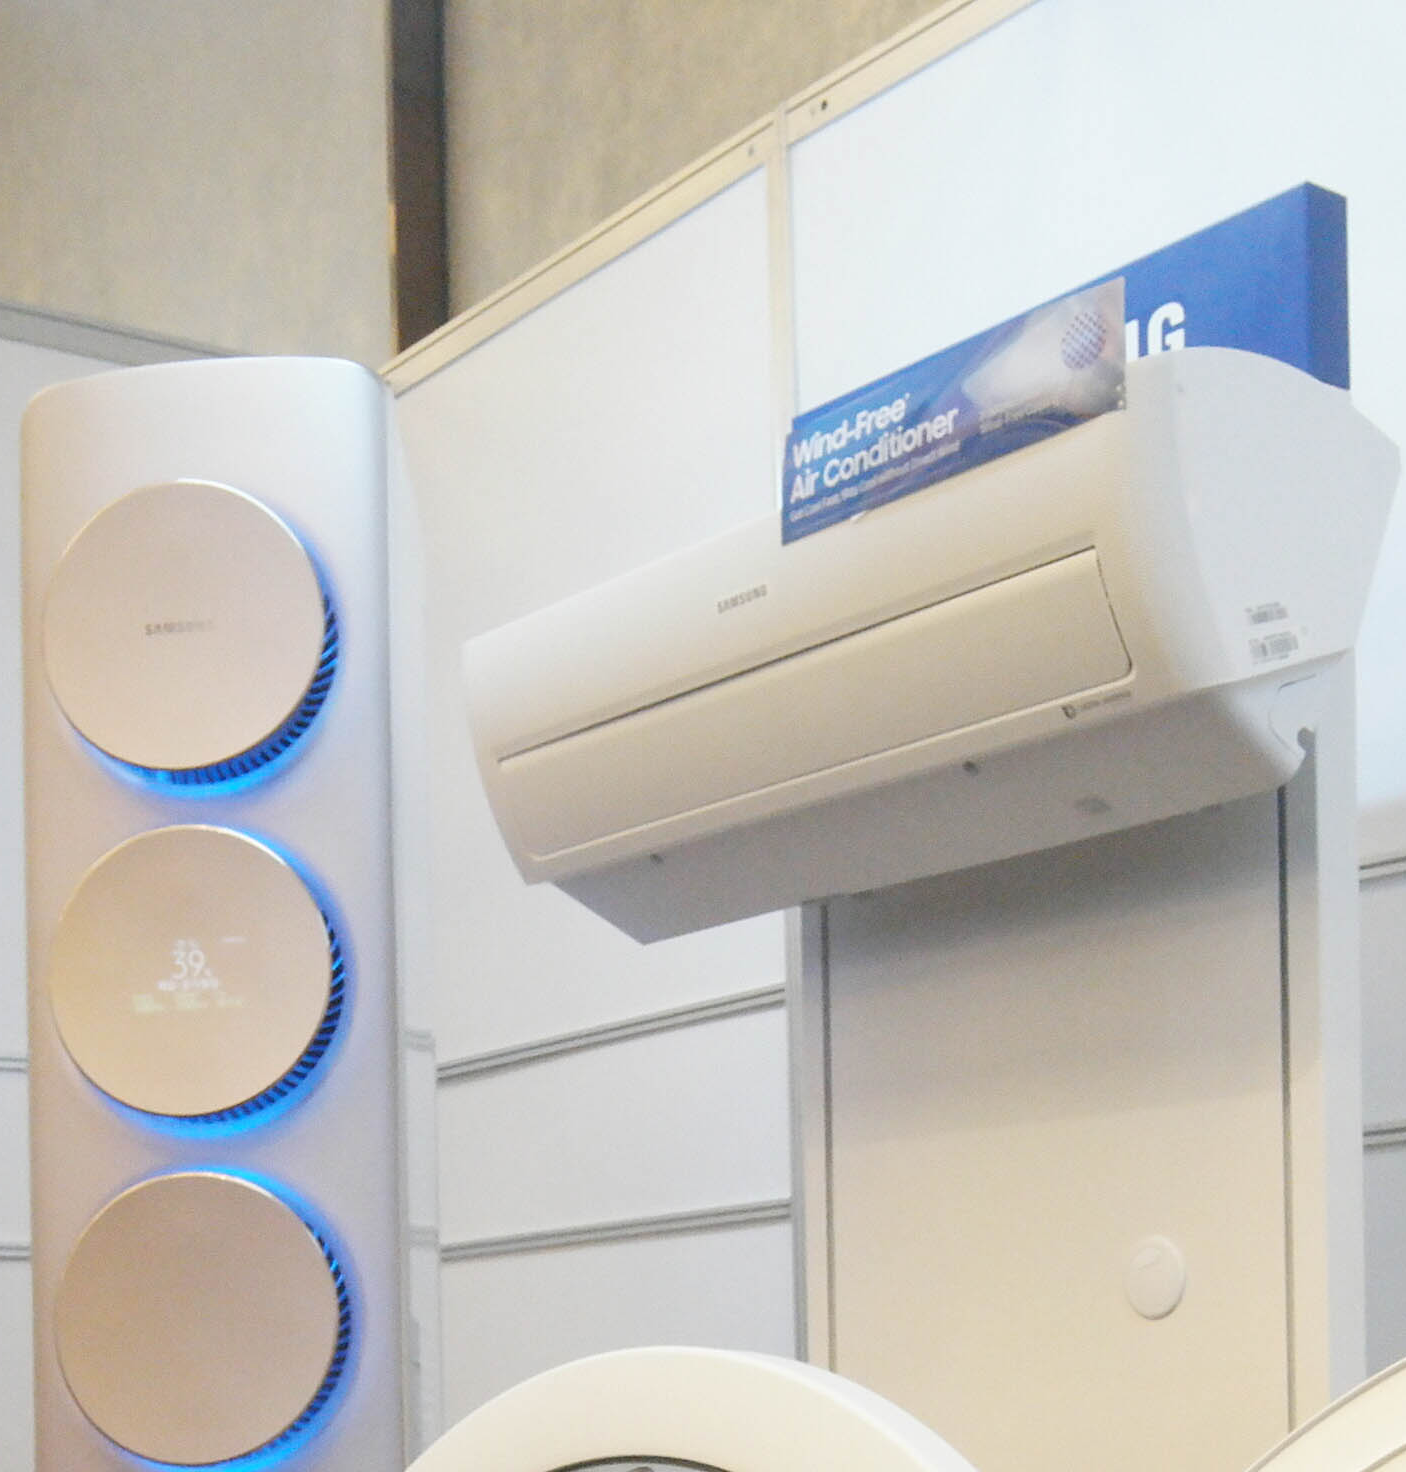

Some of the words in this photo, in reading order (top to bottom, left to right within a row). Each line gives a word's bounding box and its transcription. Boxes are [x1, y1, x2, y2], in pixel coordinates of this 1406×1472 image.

[790, 468, 820, 504] Air
[823, 408, 960, 487] Conditioner
[716, 583, 768, 615] SAMSUNG
